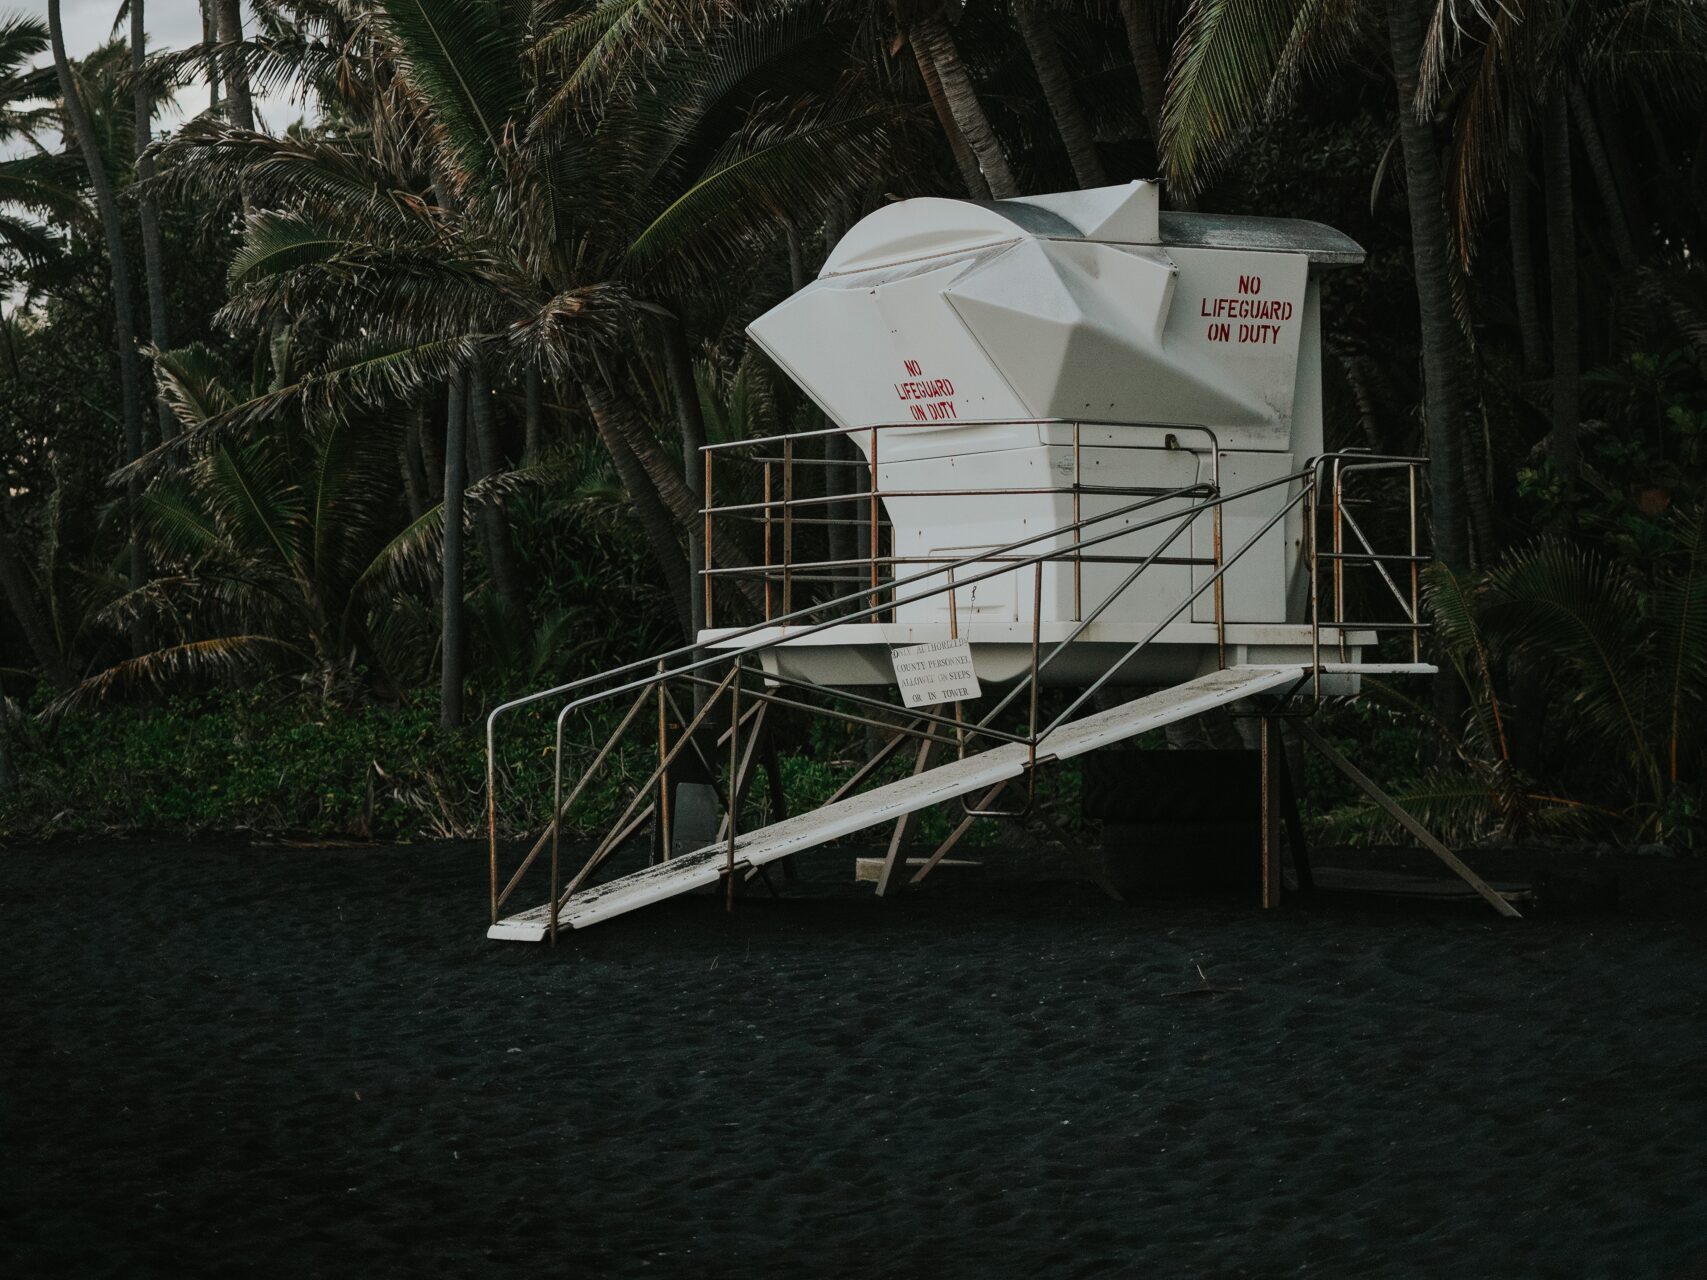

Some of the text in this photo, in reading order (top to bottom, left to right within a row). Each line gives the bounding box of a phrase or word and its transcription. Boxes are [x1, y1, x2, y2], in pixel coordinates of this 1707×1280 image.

[1239, 275, 1261, 295] NO
[1201, 298, 1292, 320] LIFEGUARD
[1208, 323, 1281, 344] ON DUTY
[904, 360, 922, 377] NO
[894, 379, 954, 400] LIFEGUARD
[910, 401, 957, 421] ON DUTY
[897, 655, 970, 672] COUNTY PERSONNEL
[949, 670, 971, 681] STEPS
[912, 687, 969, 703] OR IN TOWER
